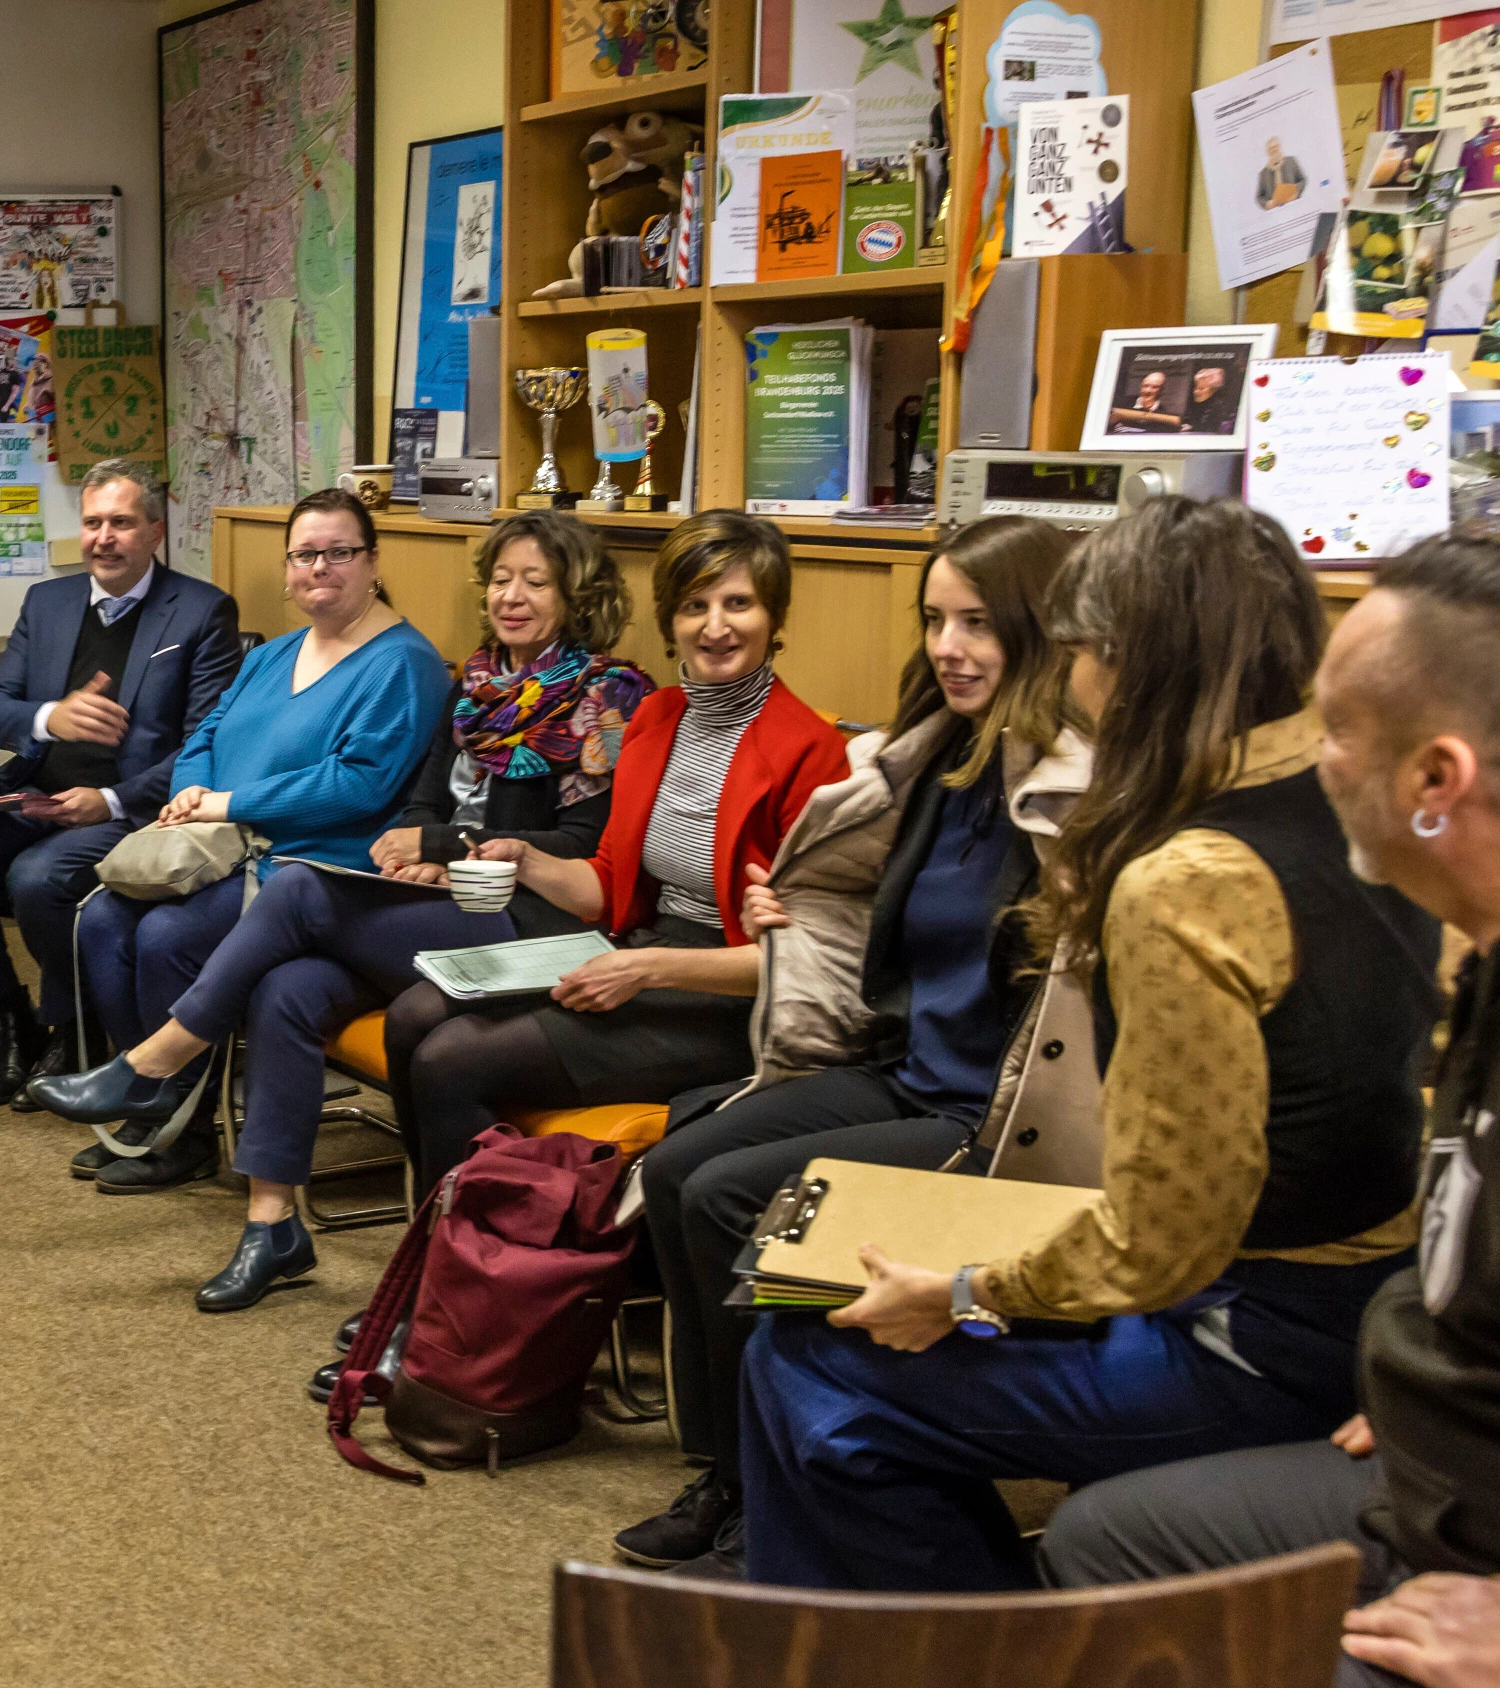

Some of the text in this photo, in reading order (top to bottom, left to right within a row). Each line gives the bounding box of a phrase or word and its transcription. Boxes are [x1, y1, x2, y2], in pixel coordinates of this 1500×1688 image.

[735, 131, 834, 149] URKUNDE
[1030, 126, 1059, 145] VON
[1027, 158, 1067, 178] GANZ
[1026, 175, 1074, 195] UNTEN
[101, 375, 116, 396] 2
[754, 386, 821, 397] BRANDENBURG
[80, 396, 96, 419] 1
[4, 452, 24, 467] AUF
